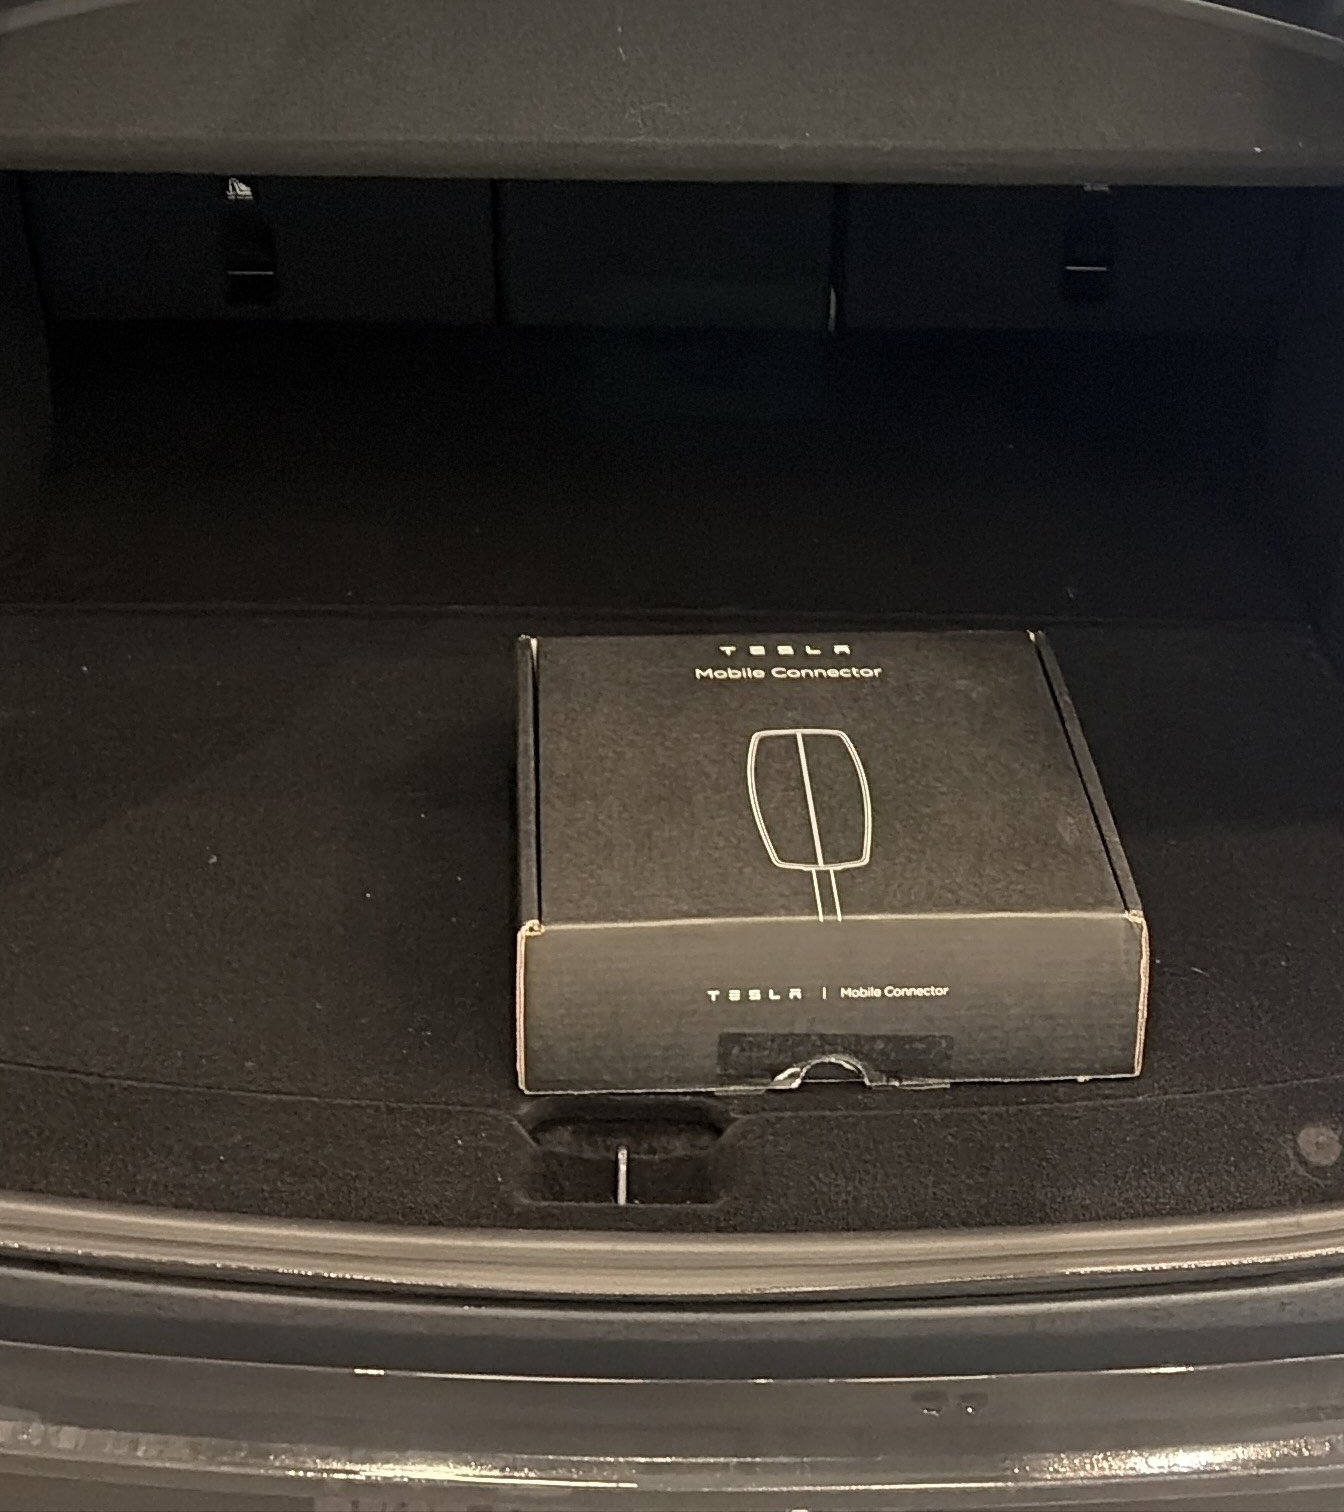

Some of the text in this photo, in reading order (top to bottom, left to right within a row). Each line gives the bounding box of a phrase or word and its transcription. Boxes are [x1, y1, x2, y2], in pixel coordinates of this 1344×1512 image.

[718, 644, 851, 656] TESLA
[694, 665, 883, 680] Mobile Connector
[705, 984, 950, 1002] TESLA Mobile Connector
